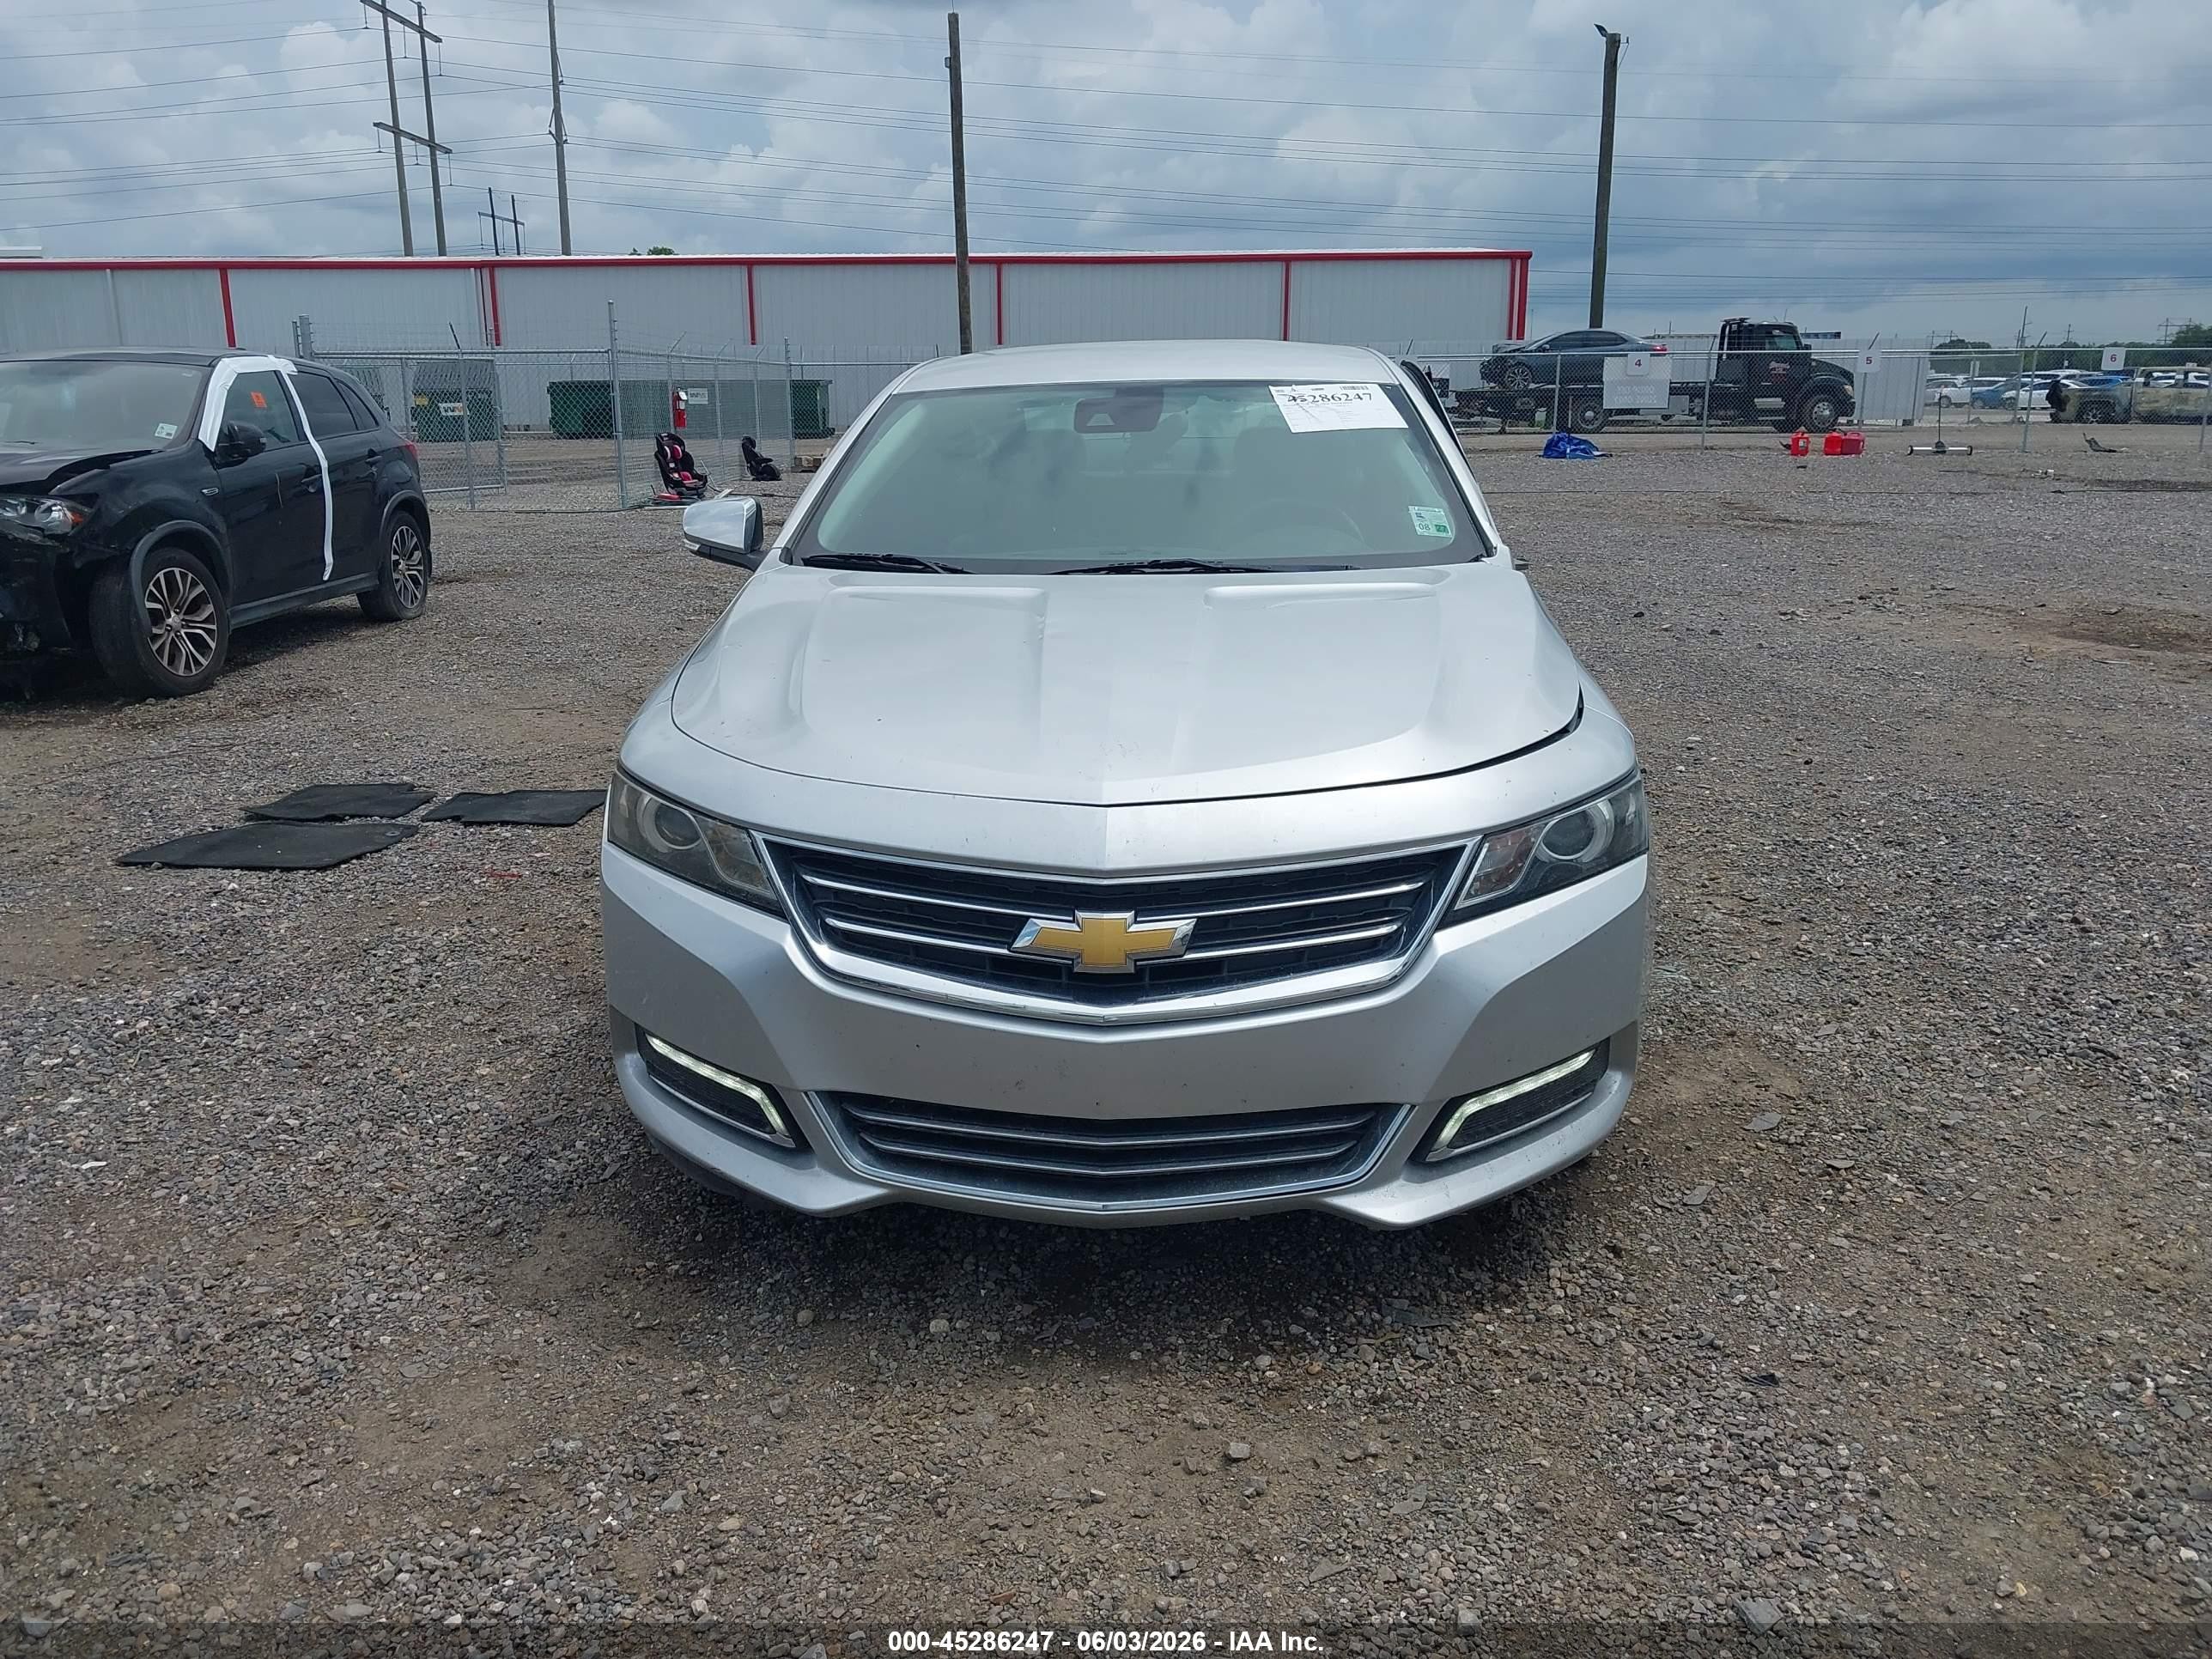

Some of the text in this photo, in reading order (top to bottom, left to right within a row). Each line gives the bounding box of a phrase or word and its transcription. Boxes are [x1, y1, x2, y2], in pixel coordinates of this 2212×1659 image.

[1865, 356, 1873, 365] 5
[2110, 353, 2118, 362] 6
[1634, 358, 1643, 368] 4
